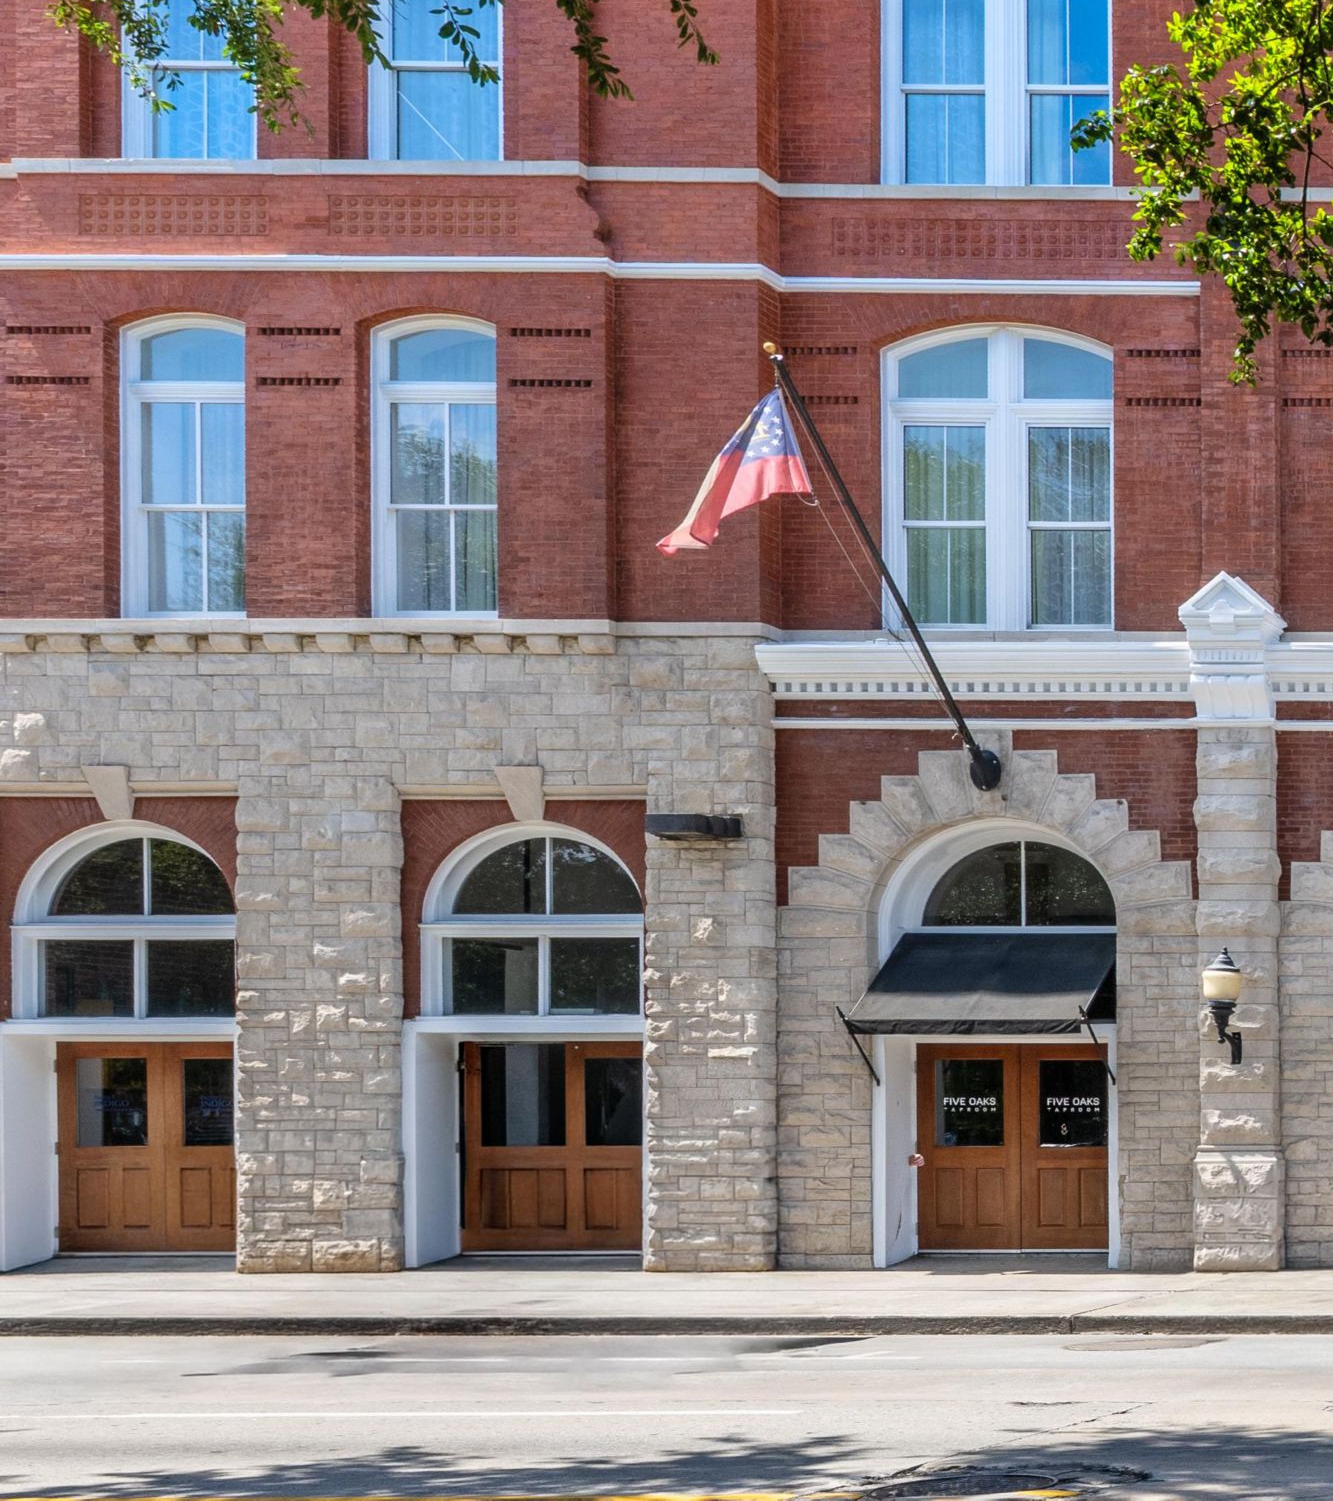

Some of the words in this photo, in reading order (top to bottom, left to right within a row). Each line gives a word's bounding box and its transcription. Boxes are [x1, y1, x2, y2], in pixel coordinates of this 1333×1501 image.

[943, 1097, 966, 1106] FIVE
[968, 1097, 997, 1106] OAKS
[1046, 1097, 1070, 1106] FIVE
[1072, 1097, 1100, 1106] OAKS
